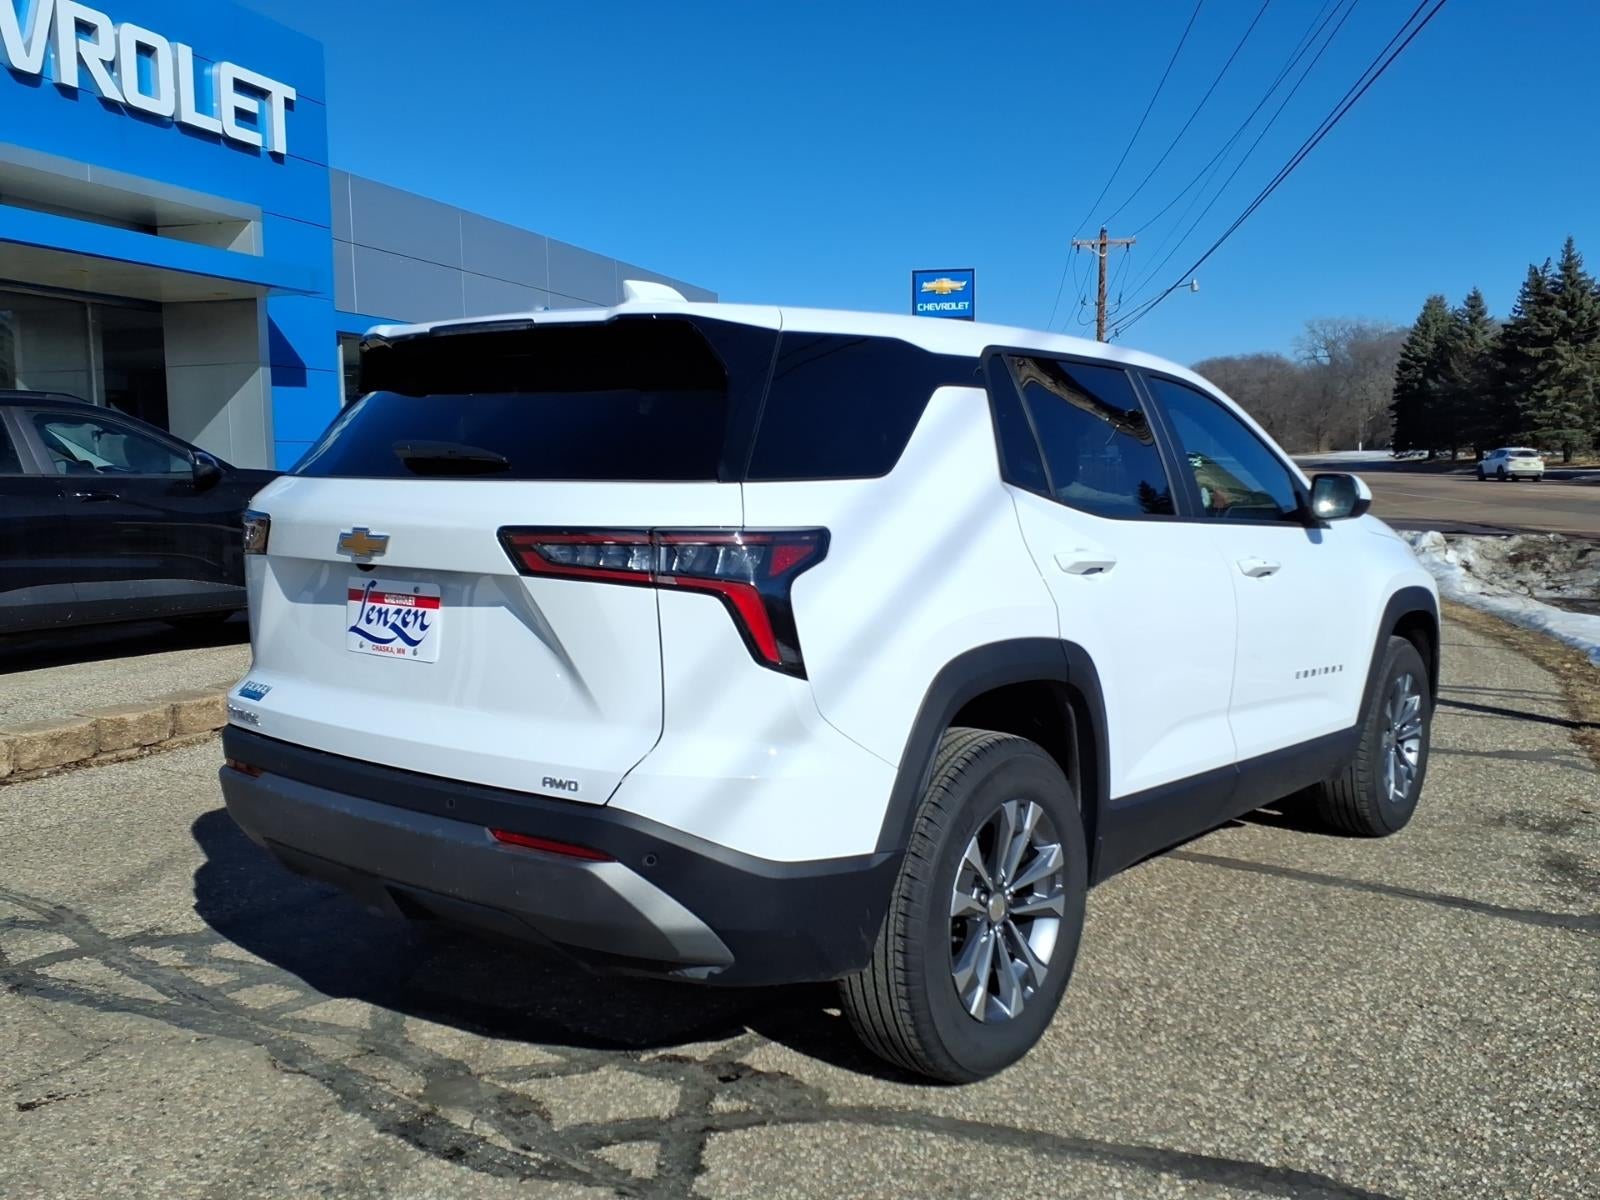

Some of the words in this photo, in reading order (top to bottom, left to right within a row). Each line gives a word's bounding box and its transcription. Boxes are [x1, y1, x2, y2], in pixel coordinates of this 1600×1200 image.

[0, 0, 296, 155] VROLET
[917, 301, 969, 312] CHEVROLET
[348, 580, 431, 647] Lenzen
[542, 776, 578, 792] AWD
